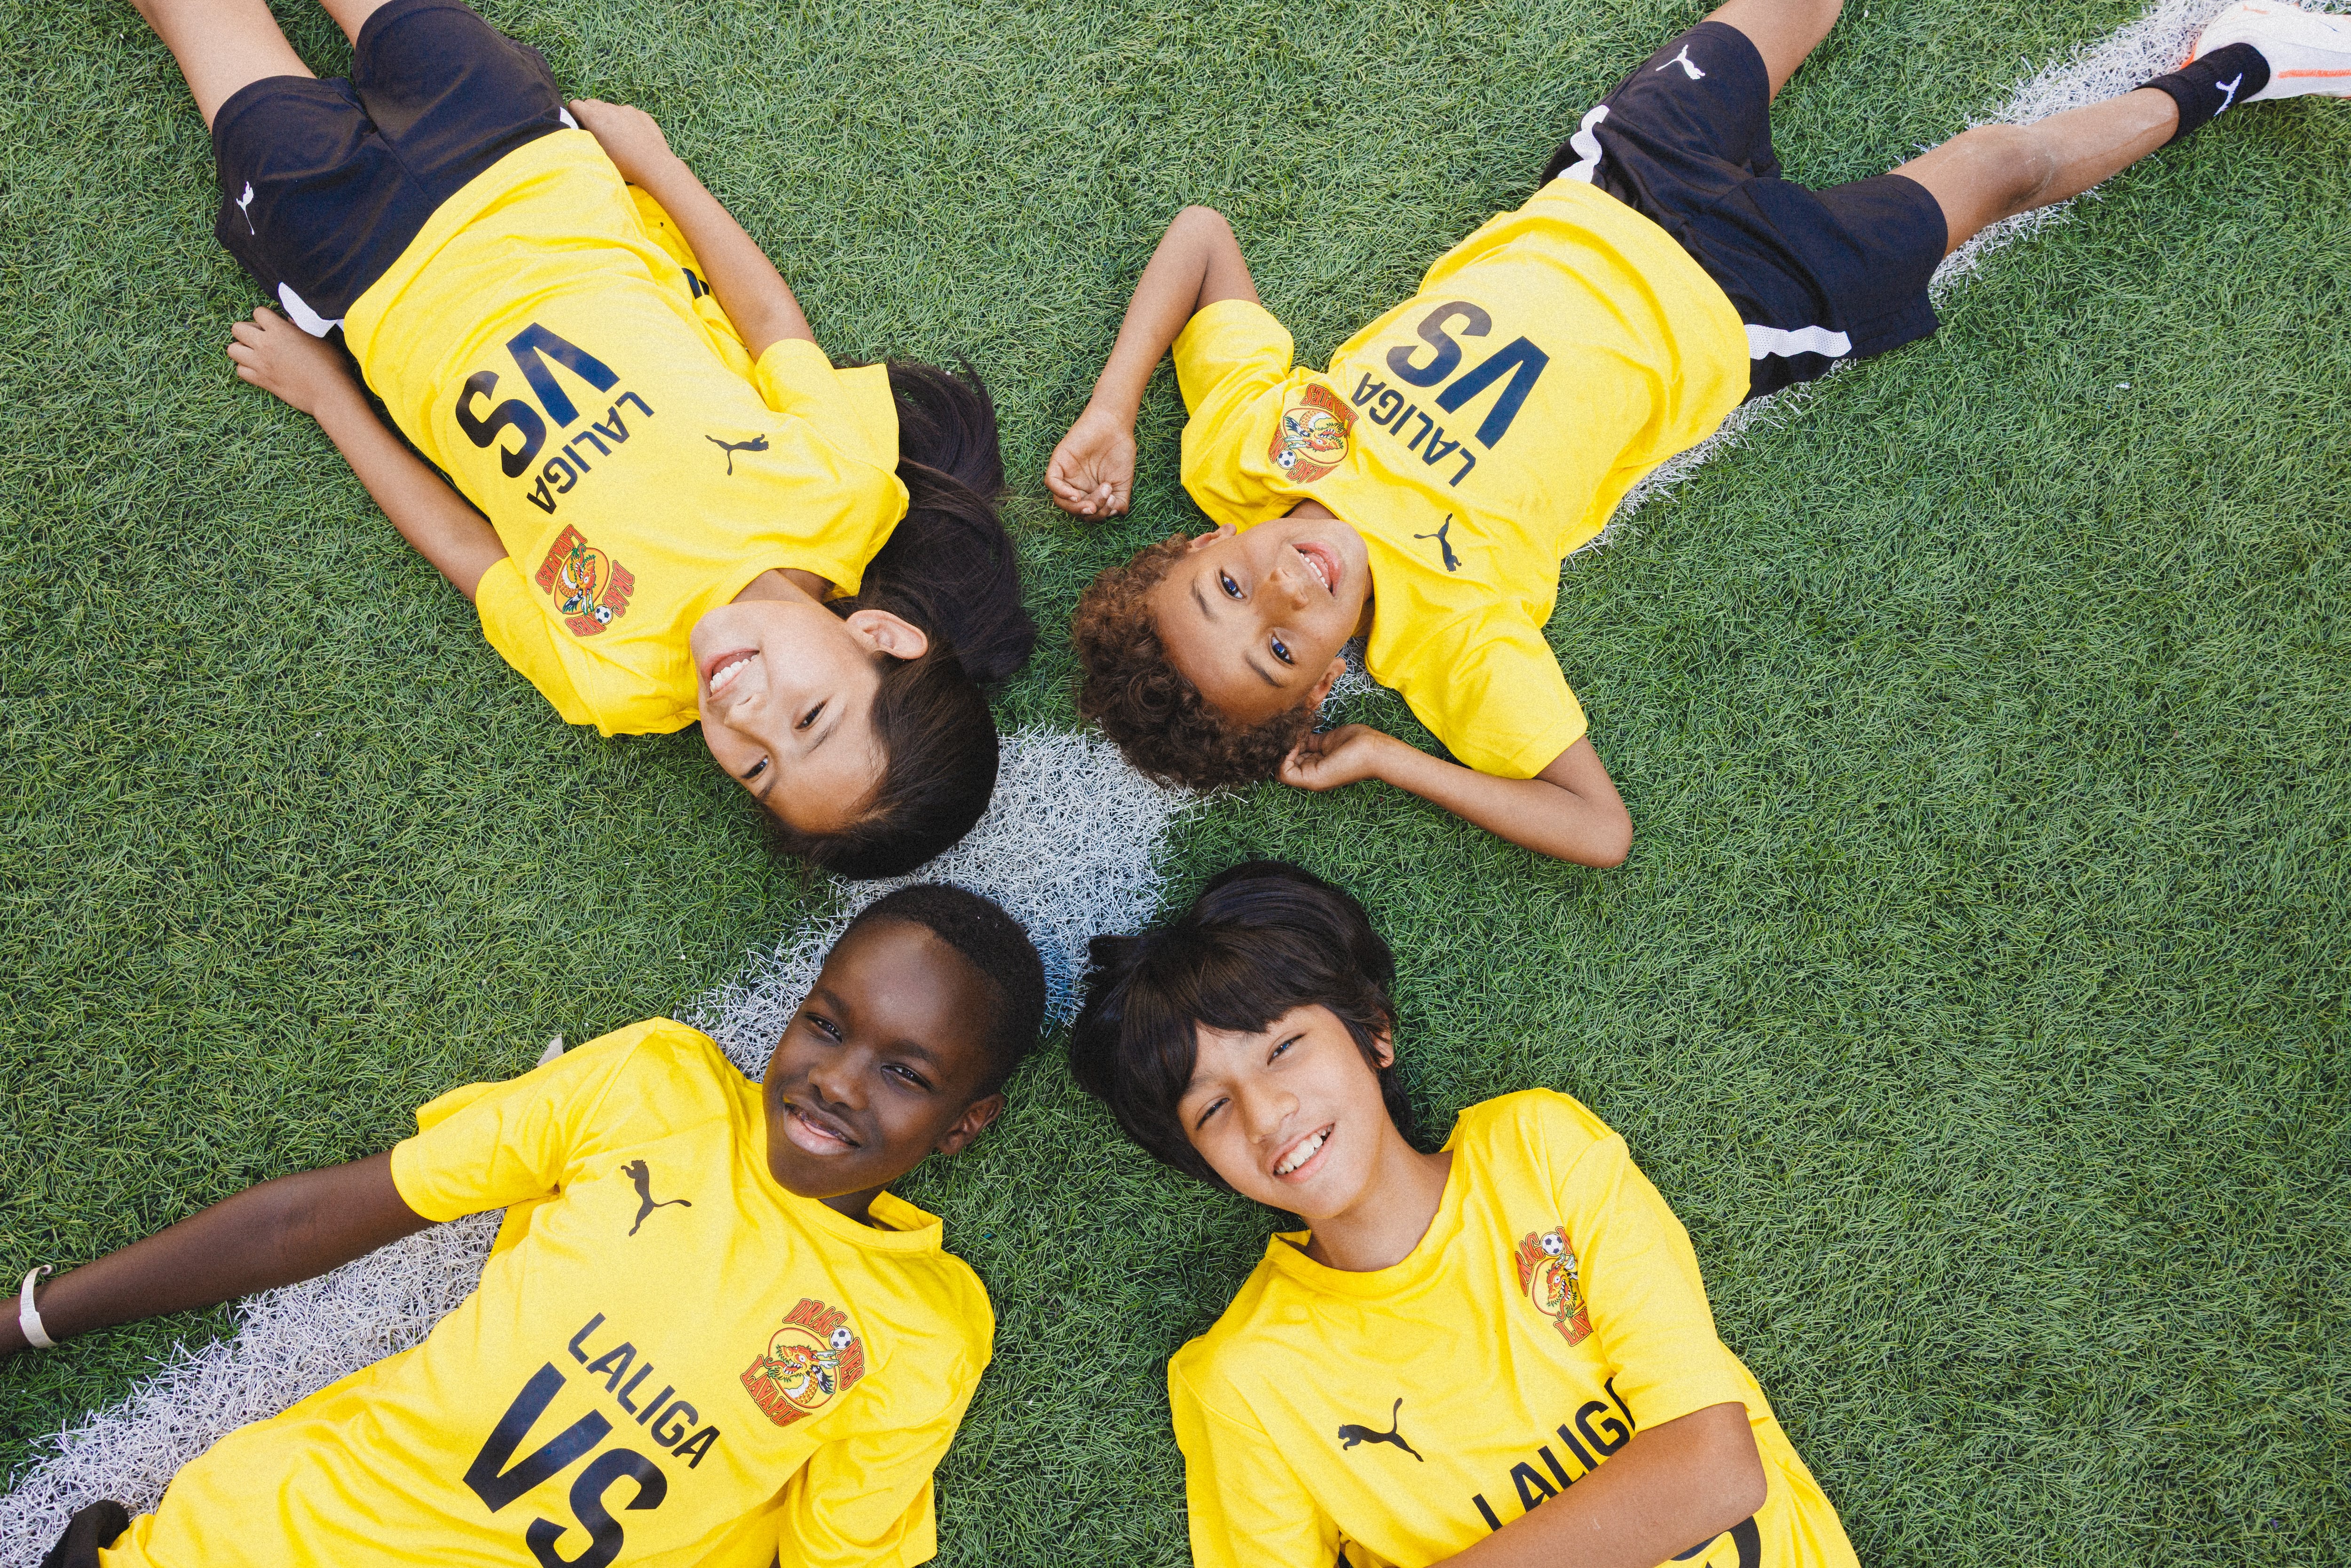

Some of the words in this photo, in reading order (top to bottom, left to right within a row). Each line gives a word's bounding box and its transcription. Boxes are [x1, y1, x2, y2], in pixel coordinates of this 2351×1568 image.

[456, 323, 620, 478] VS
[1352, 372, 1476, 487] LALIGA
[1387, 302, 1549, 449] VS
[527, 392, 654, 514] LALIGA
[535, 524, 588, 594] LAVAPIES
[568, 1313, 720, 1469] LALIGA
[463, 1362, 667, 1568] VS
